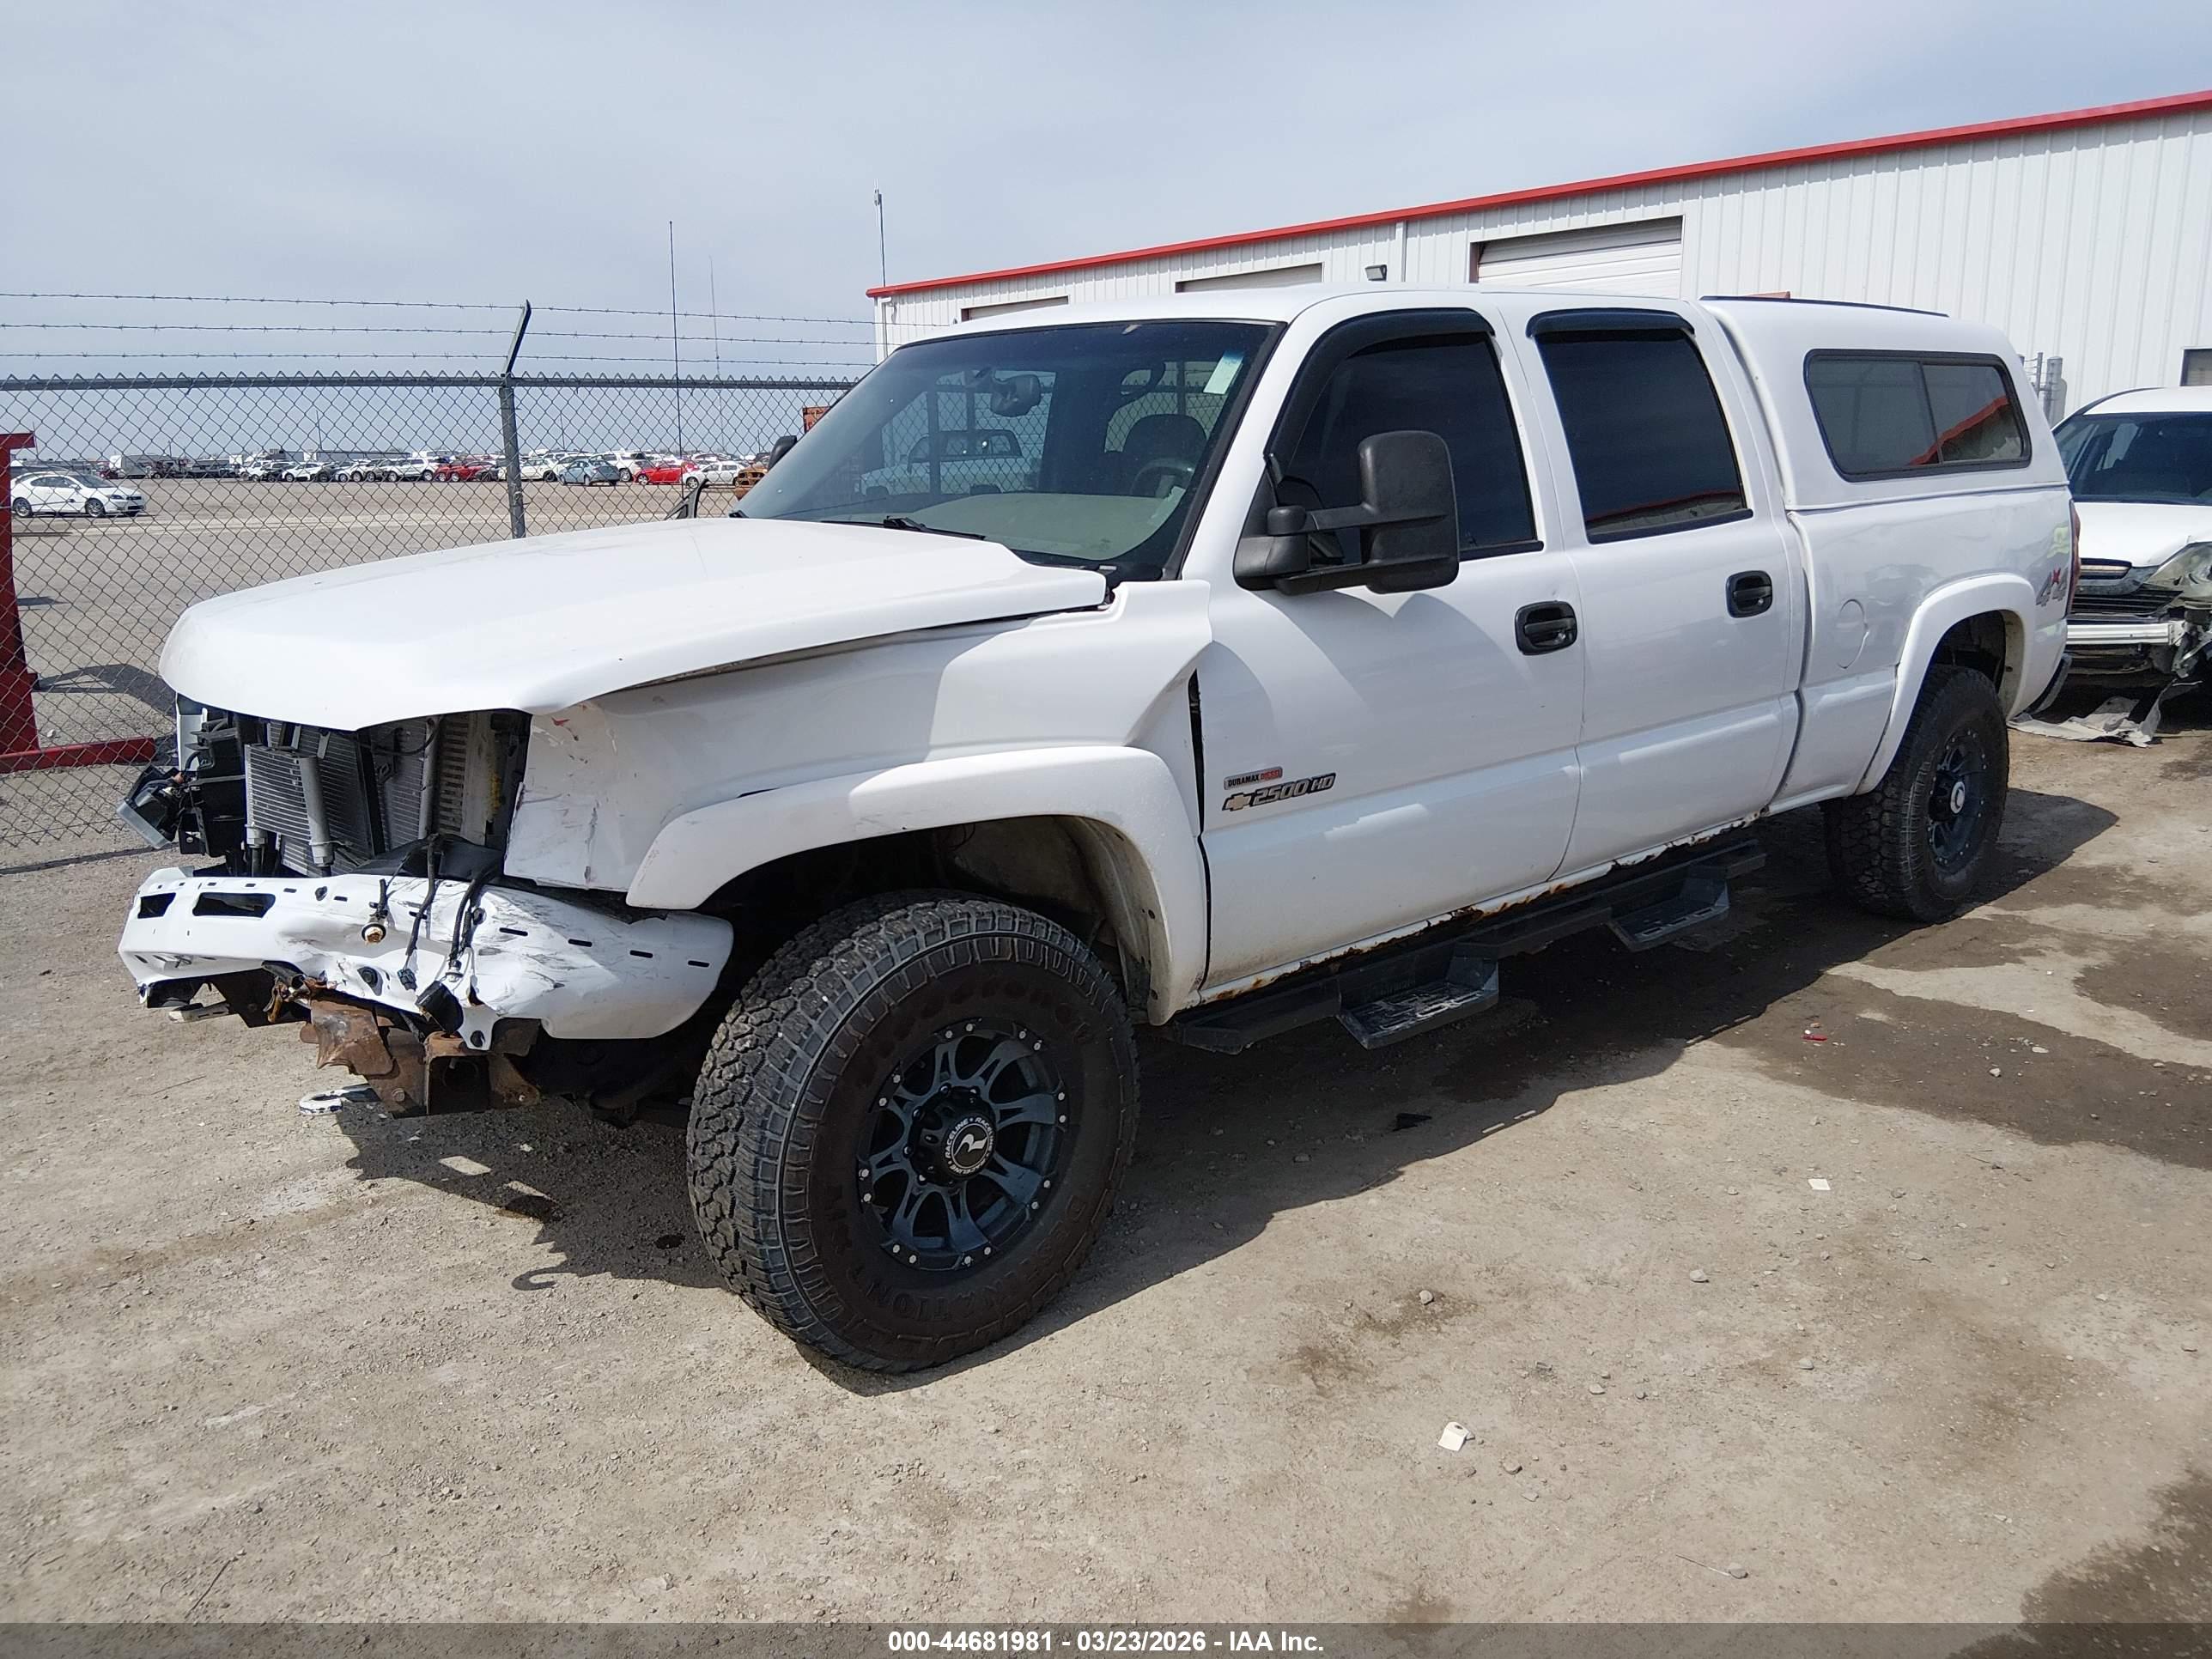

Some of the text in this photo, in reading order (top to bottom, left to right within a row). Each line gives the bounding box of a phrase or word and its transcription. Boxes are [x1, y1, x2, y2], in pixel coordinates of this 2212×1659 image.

[1227, 774, 1260, 787] DURAMAX
[1252, 775, 1335, 806] 2500 HD
[945, 1118, 969, 1158] RACELINE
